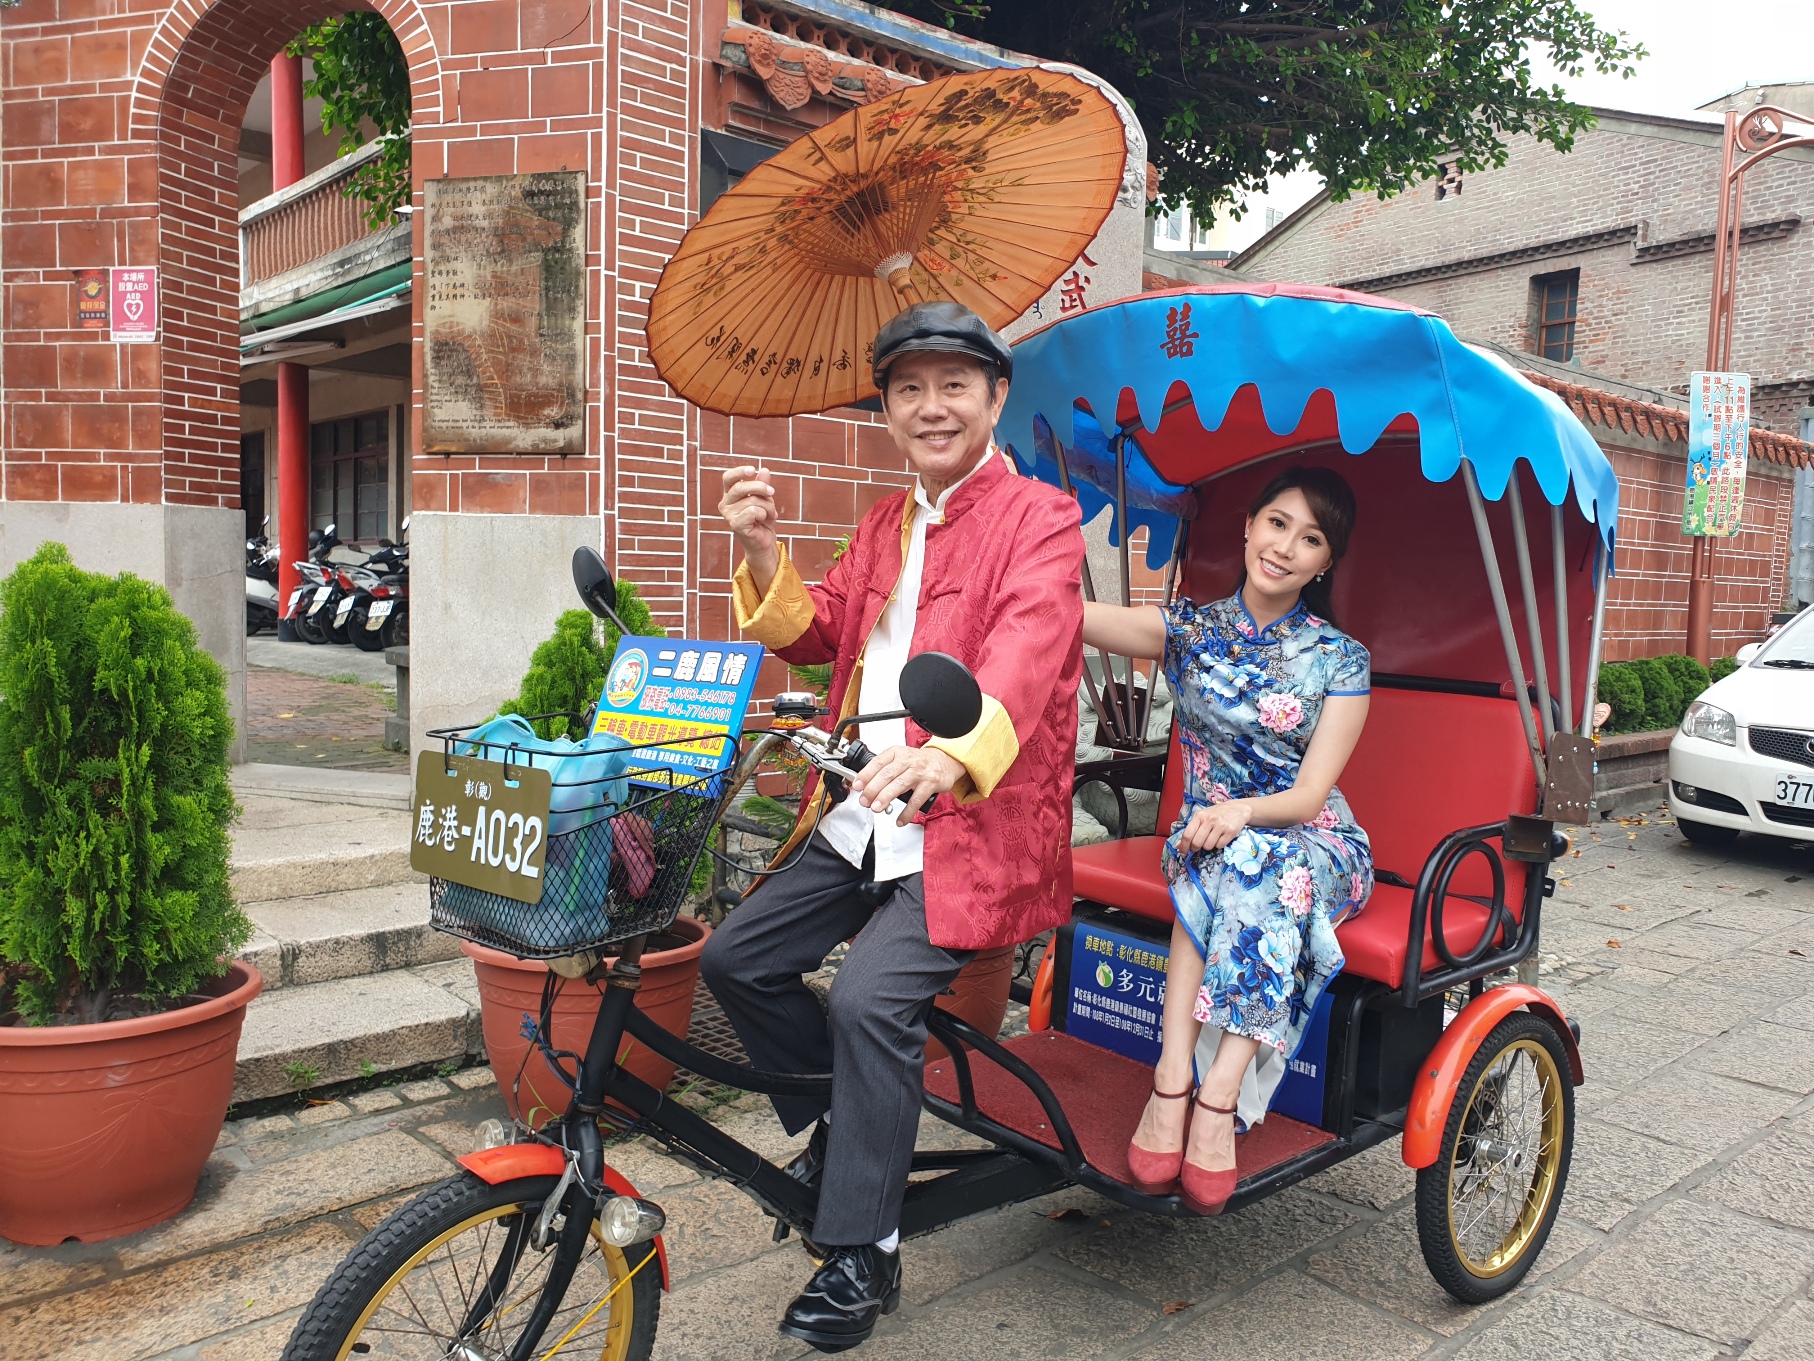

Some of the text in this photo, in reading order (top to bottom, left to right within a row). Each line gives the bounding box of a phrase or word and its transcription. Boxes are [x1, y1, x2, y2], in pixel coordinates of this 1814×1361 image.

[118, 282, 148, 291] 設置AED
[122, 272, 145, 281] 本場所
[651, 650, 748, 686] 二鹿風情
[464, 779, 492, 800] 彰(觀)
[1776, 781, 1814, 804] 377
[415, 799, 543, 878] 鹿港-A032
